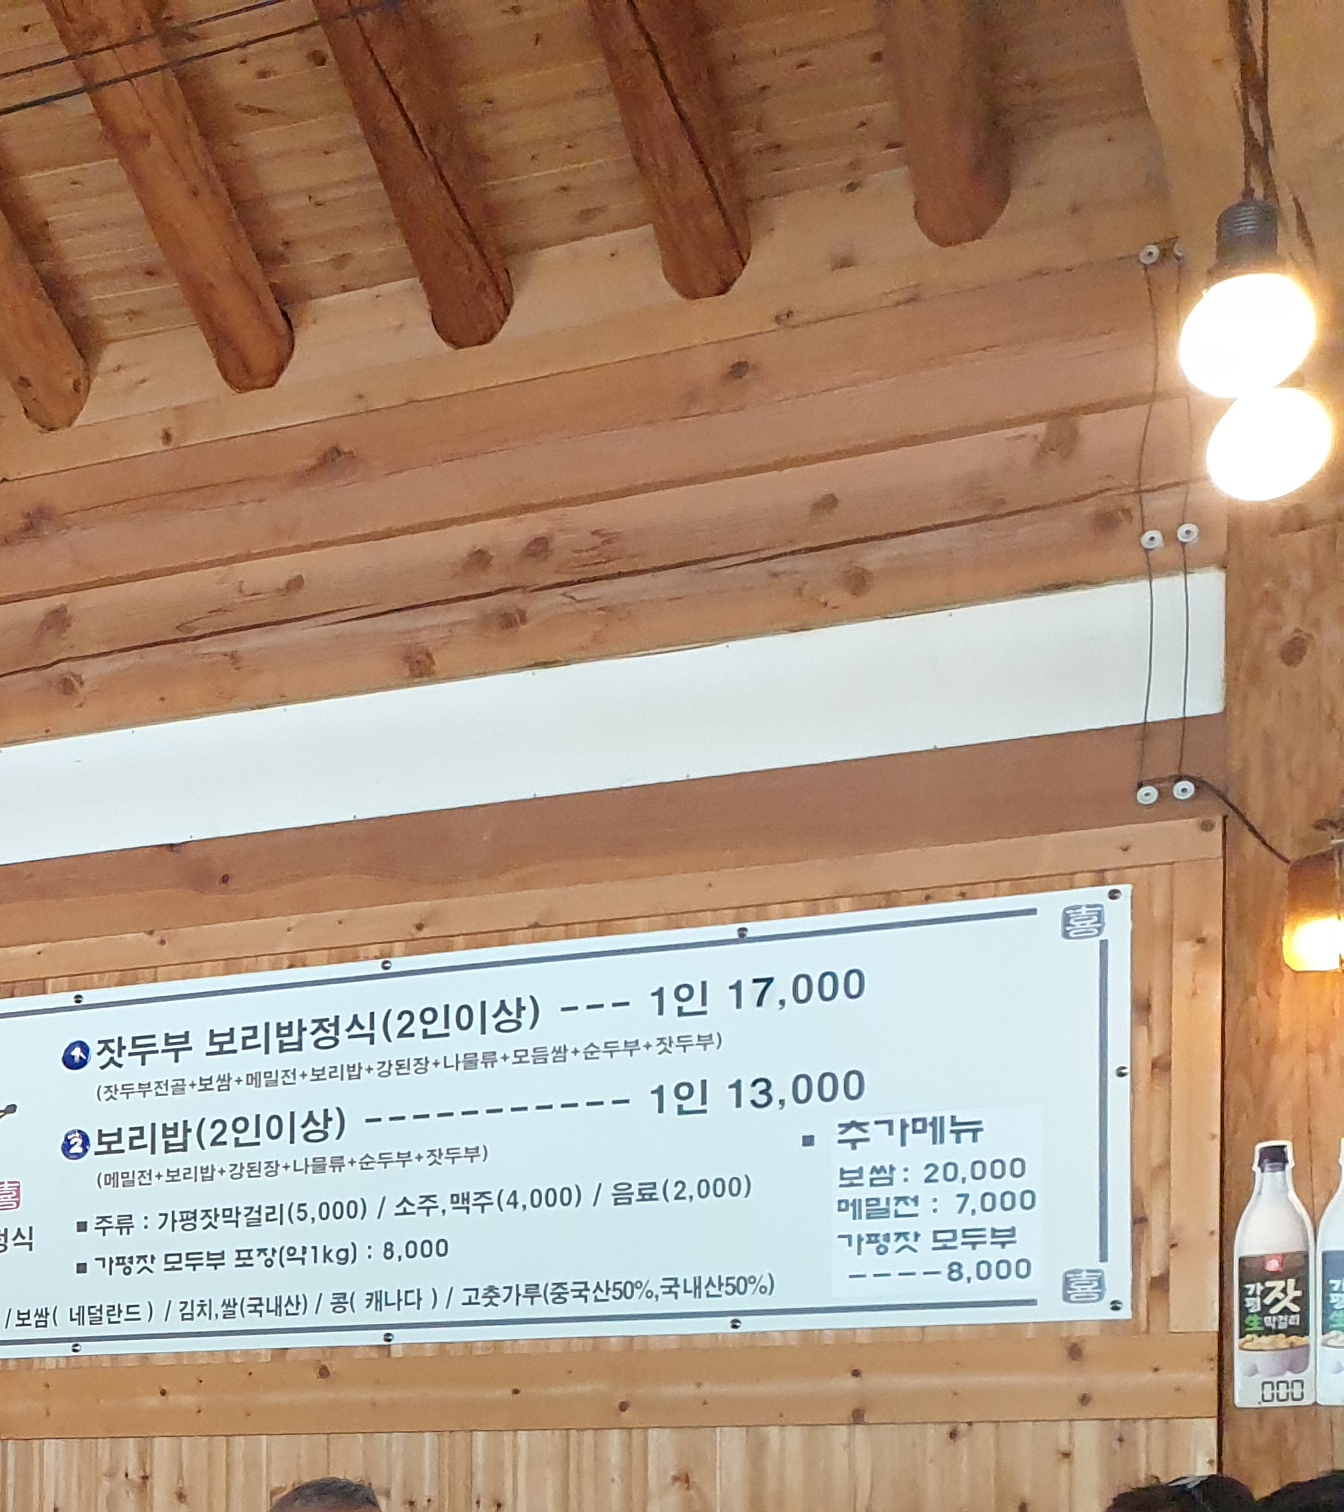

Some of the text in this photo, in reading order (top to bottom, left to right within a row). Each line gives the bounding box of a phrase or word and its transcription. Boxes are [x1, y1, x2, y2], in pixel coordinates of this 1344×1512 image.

[96, 1030, 193, 1070] 잣두부
[205, 995, 541, 1057] 보리밥정식(2인이상)
[650, 980, 709, 1018] 1인
[727, 968, 866, 1010] 17,000
[94, 1107, 346, 1157] 보리밥(2인이상)
[650, 1079, 709, 1116] 1인
[727, 1070, 866, 1110] 13,000
[837, 1115, 985, 1151] 추가메뉴
[923, 1157, 1026, 1185] 20,000
[94, 1174, 752, 1237] 주류 가평잣막걸리(5,000) 소주,맥주(4,000) 음료(2,000)
[837, 1189, 1037, 1221] 메밀전 7,000
[95, 1238, 449, 1277] 가평잣 모두부 포장(약1kg) 8,000
[837, 1226, 1017, 1256] 가평잣 모두부
[69, 1301, 143, 1327] 네덜란드
[365, 1288, 424, 1313] 캐나다
[1263, 1278, 1303, 1315] 잣
